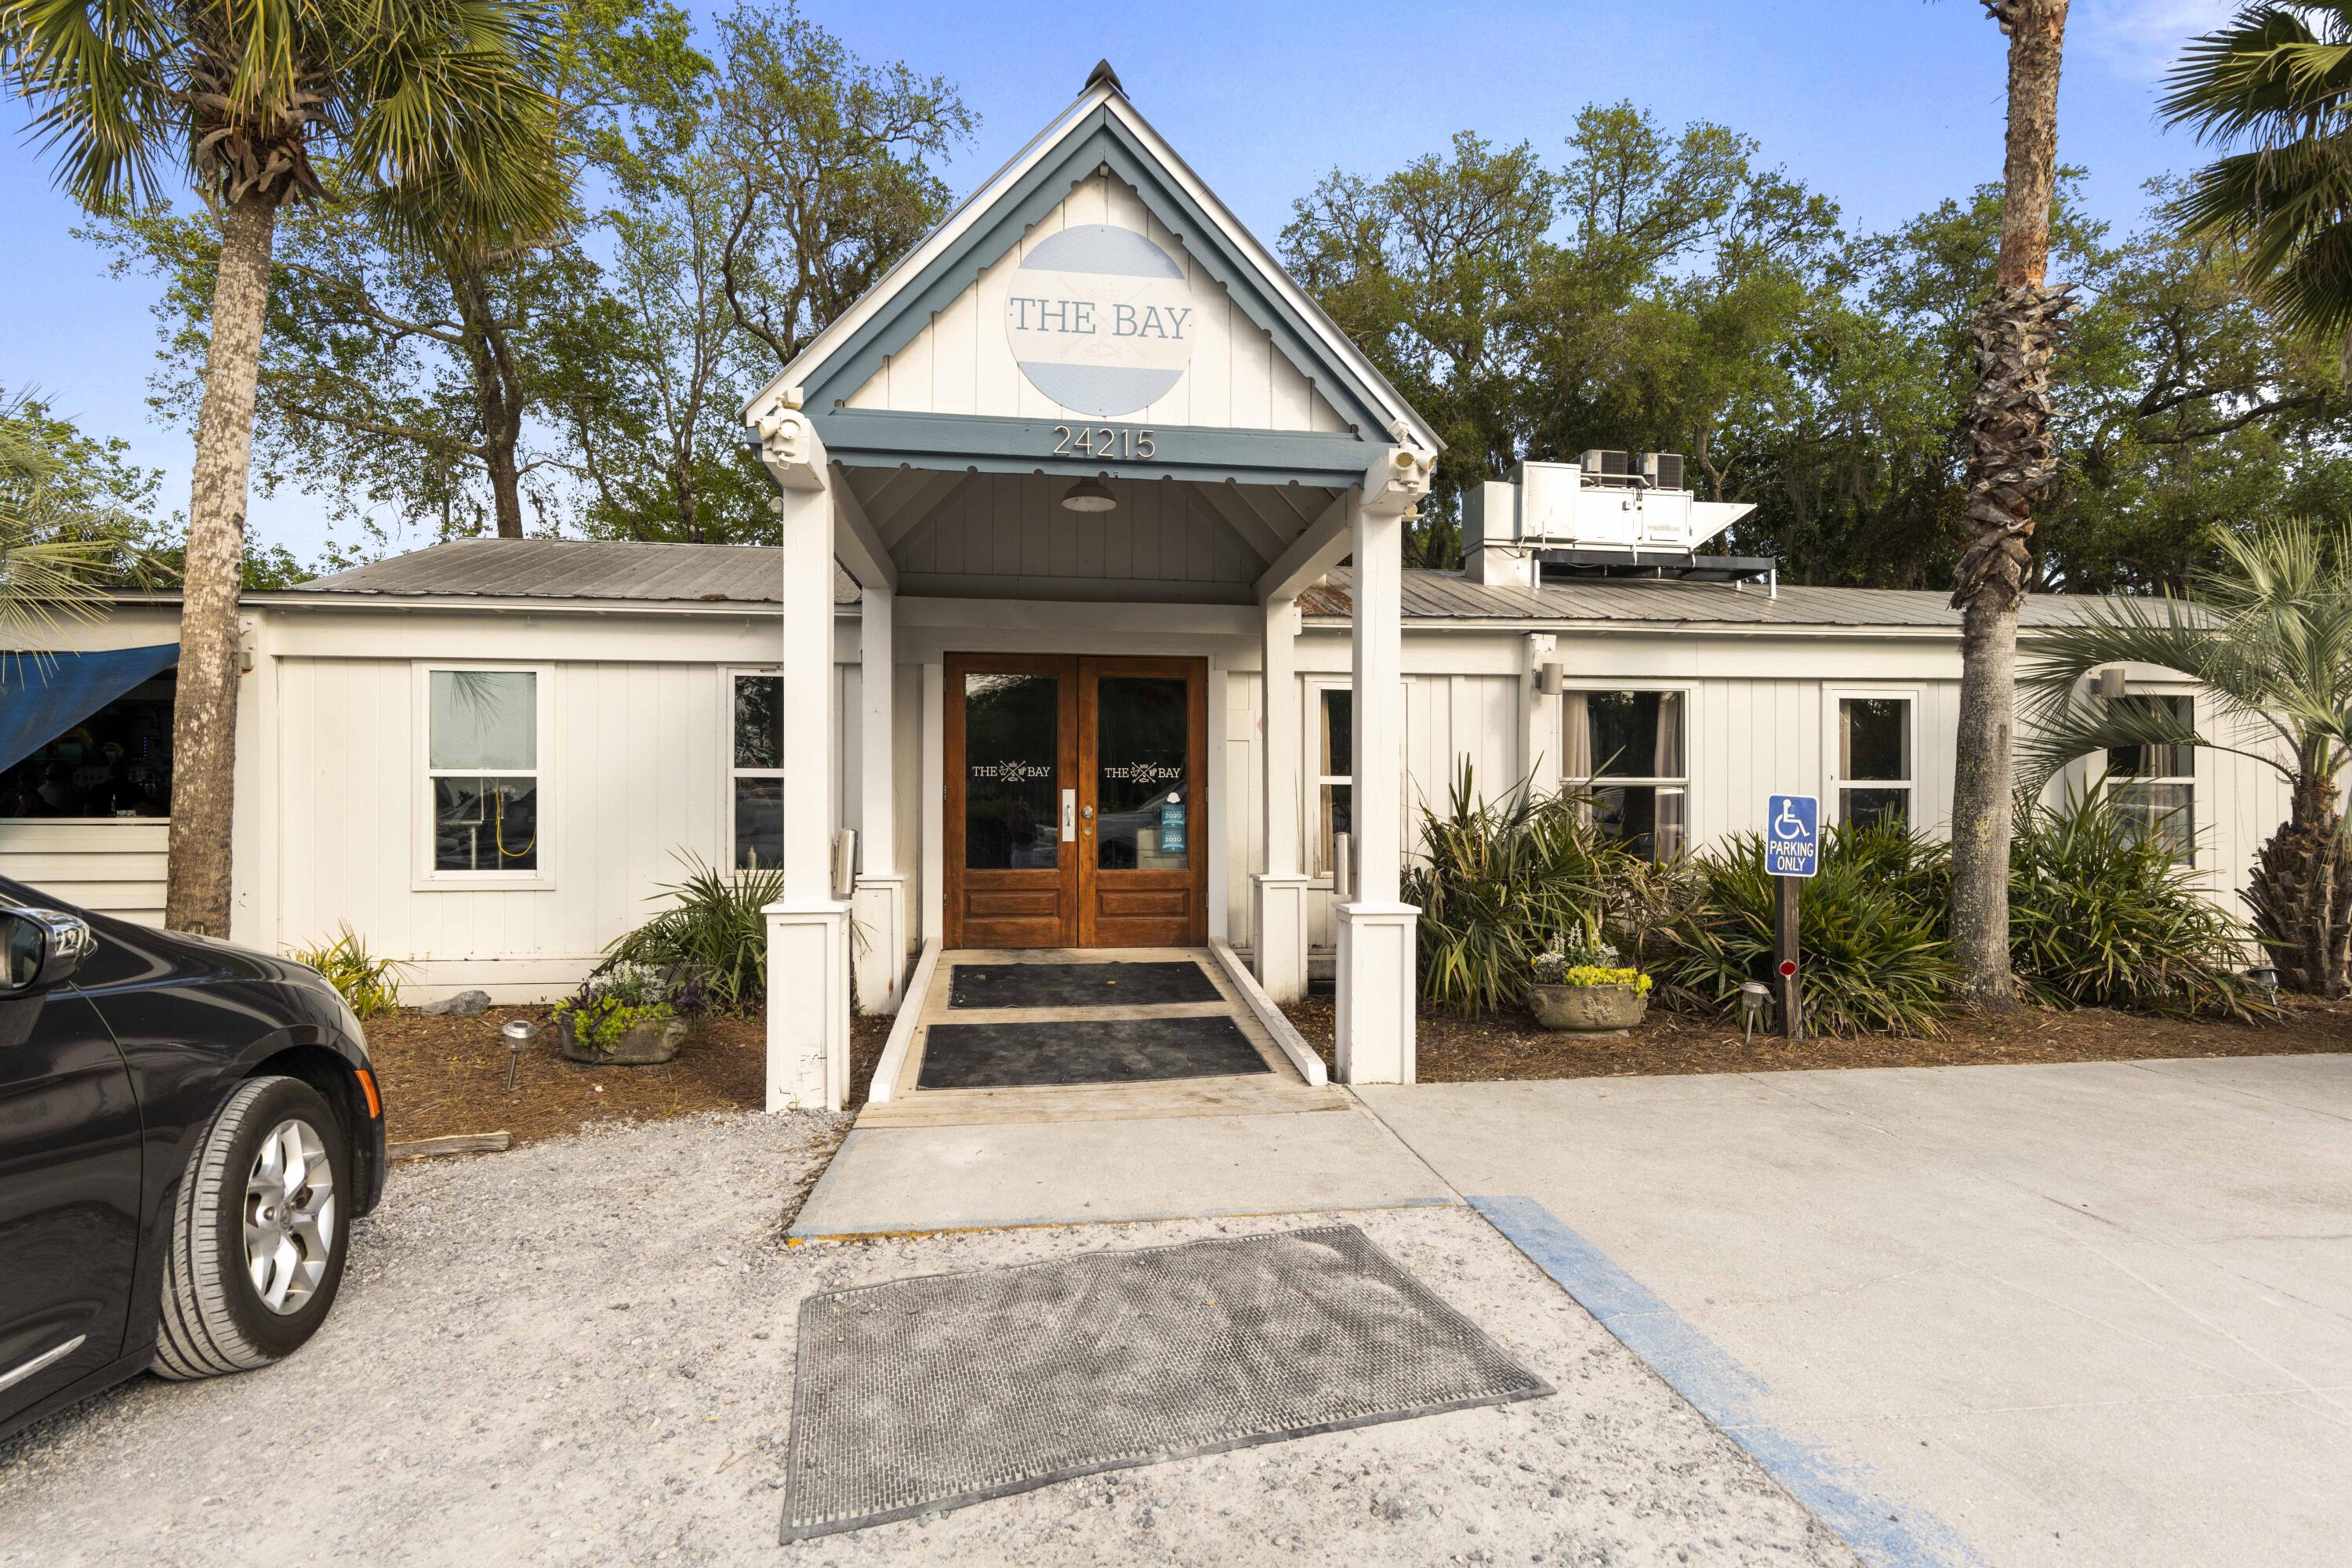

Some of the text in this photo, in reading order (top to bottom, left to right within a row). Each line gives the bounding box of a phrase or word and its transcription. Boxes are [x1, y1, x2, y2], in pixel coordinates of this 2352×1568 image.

[1010, 297, 1192, 339] THE BAY
[1053, 425, 1156, 459] 24215
[972, 766, 1051, 777] THE BAY
[1104, 768, 1181, 778] THE BAY
[1769, 840, 1814, 858] PARKING
[1777, 855, 1806, 872] ONLY
